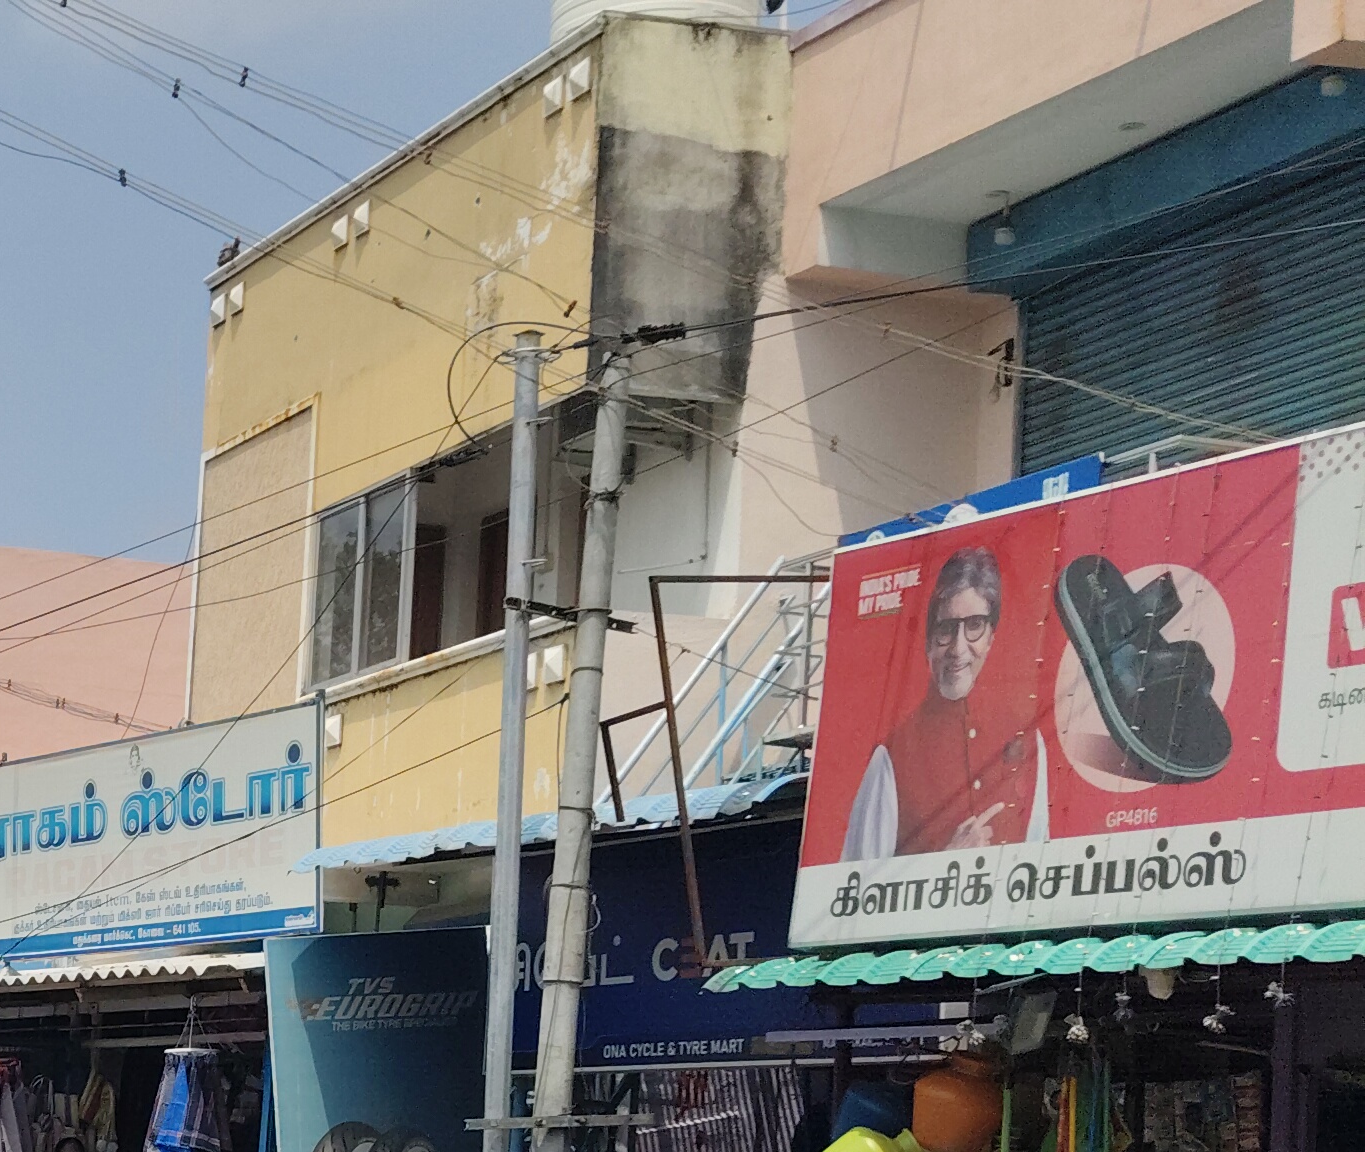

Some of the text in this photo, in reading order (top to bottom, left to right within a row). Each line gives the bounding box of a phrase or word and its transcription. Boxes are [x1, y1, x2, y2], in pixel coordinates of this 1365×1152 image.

[119, 740, 312, 838] ஸ்டோர்
[1106, 807, 1159, 828] GP4816
[830, 831, 1247, 918] கிளாசிக் செப்பல்ஸ்
[172, 924, 186, 935] 641
[651, 932, 755, 982] CEAT
[348, 976, 396, 995] TVS
[310, 990, 479, 1021] EUROGRIP
[332, 1021, 350, 1031] THE
[629, 1042, 665, 1057] CYCLE
[667, 1043, 677, 1056] &
[677, 1041, 708, 1055] TYRE
[710, 1038, 744, 1054] MART
